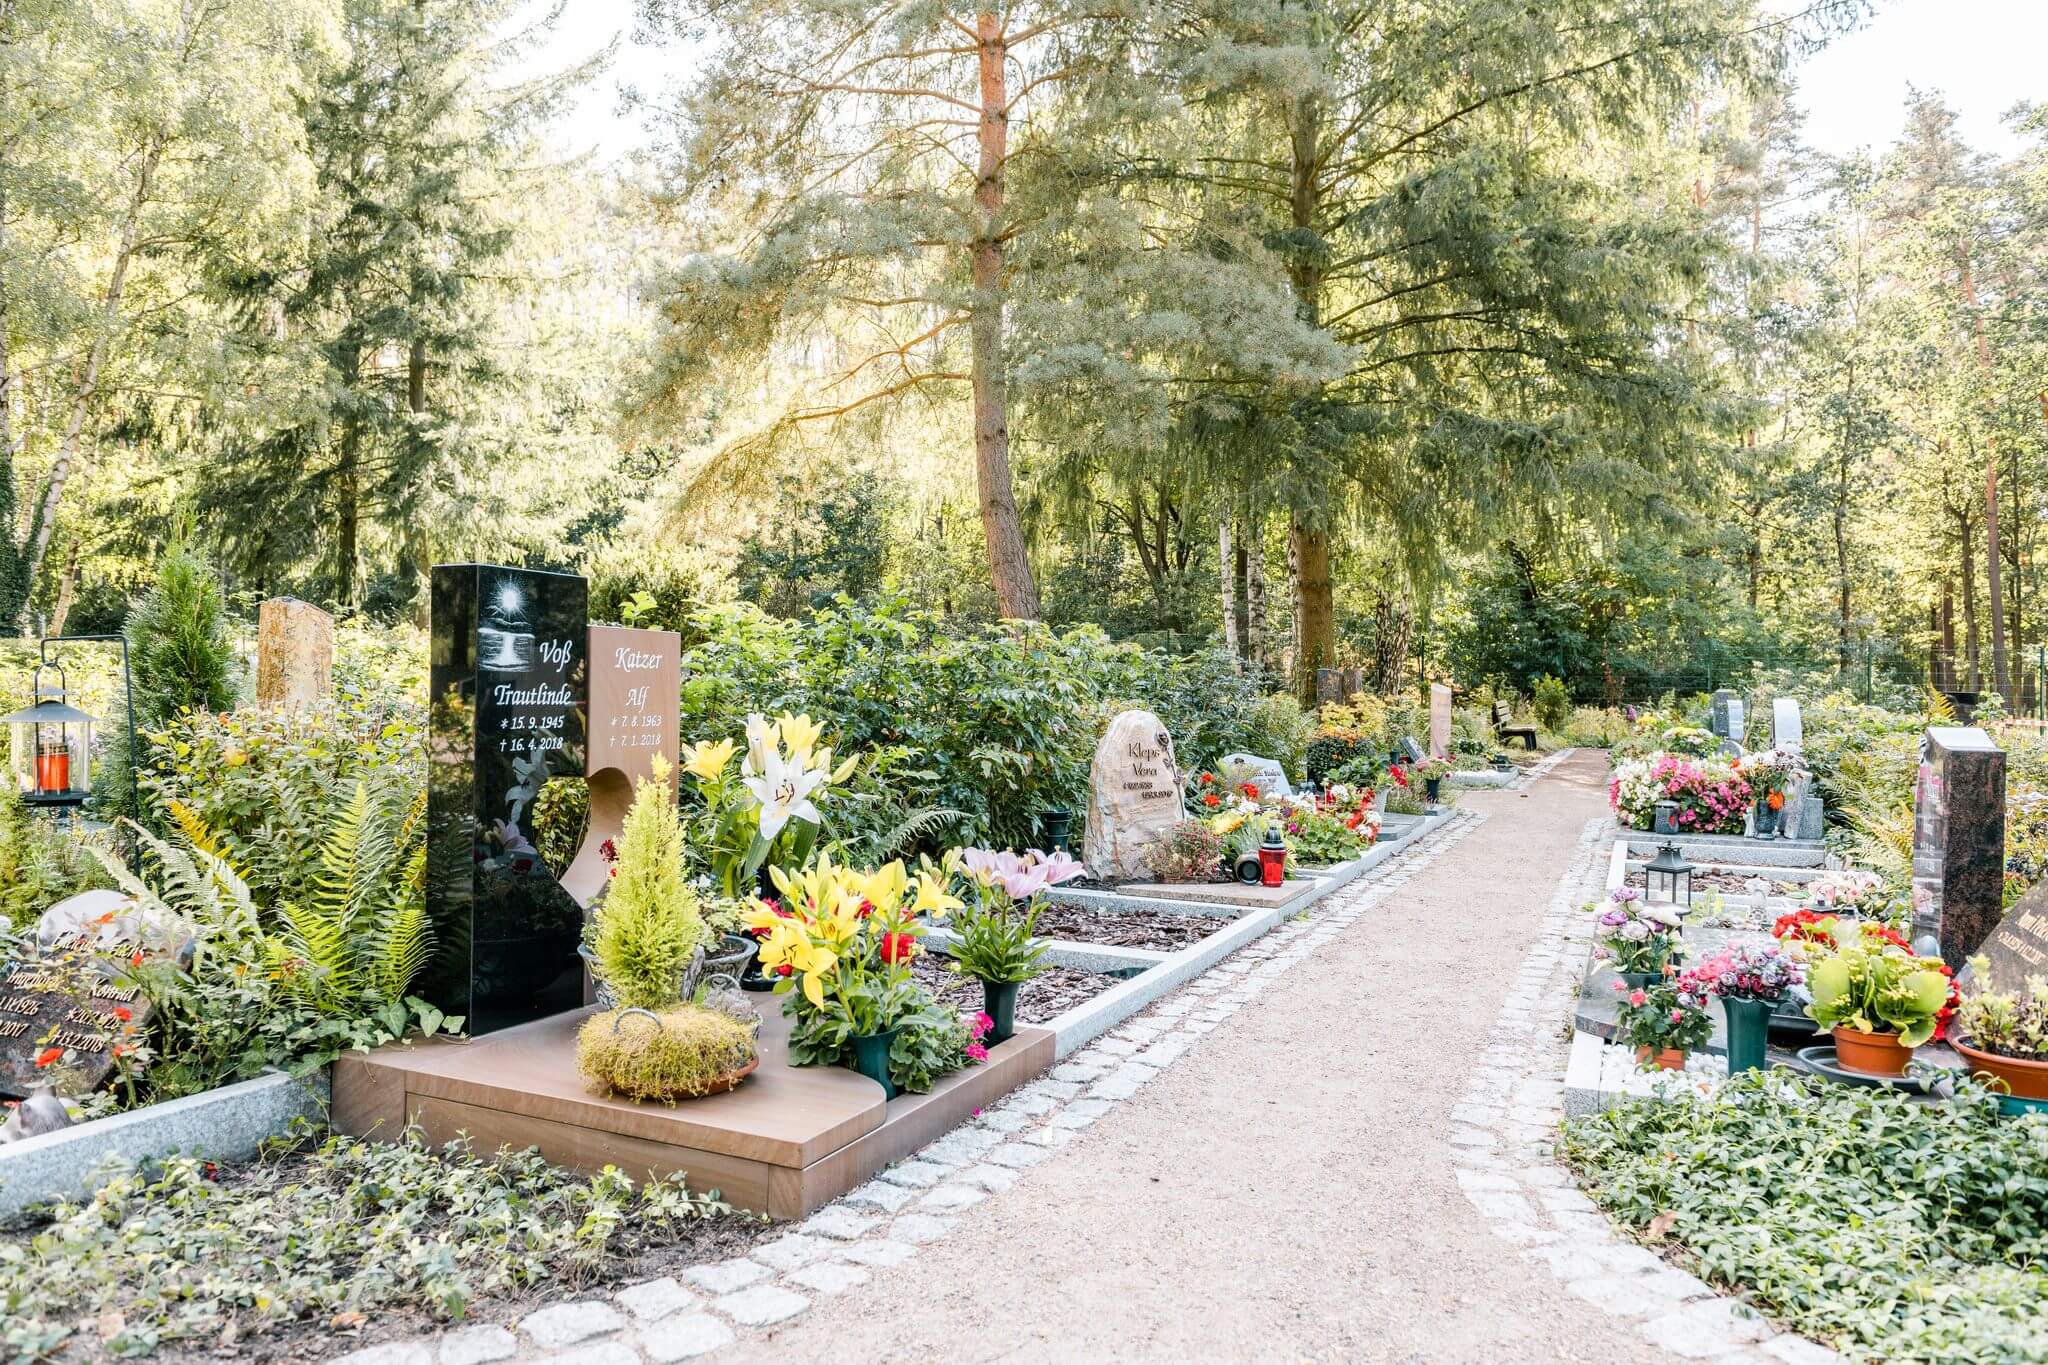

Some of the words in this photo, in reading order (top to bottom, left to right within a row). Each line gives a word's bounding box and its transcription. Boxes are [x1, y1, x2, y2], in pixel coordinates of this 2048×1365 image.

[540, 639, 572, 672] Voß
[614, 647, 662, 672] Katzer
[494, 683, 572, 706] Trautlinde
[626, 686, 650, 713] Alf
[510, 715, 525, 730] 15.
[528, 716, 538, 729] 9.
[540, 715, 565, 729] 1945
[642, 715, 662, 727] 1963
[509, 737, 525, 752] 16.
[528, 737, 537, 751] 4.
[539, 736, 564, 750] 2018
[640, 734, 661, 746] 2018
[1132, 762, 1158, 777] Vera
